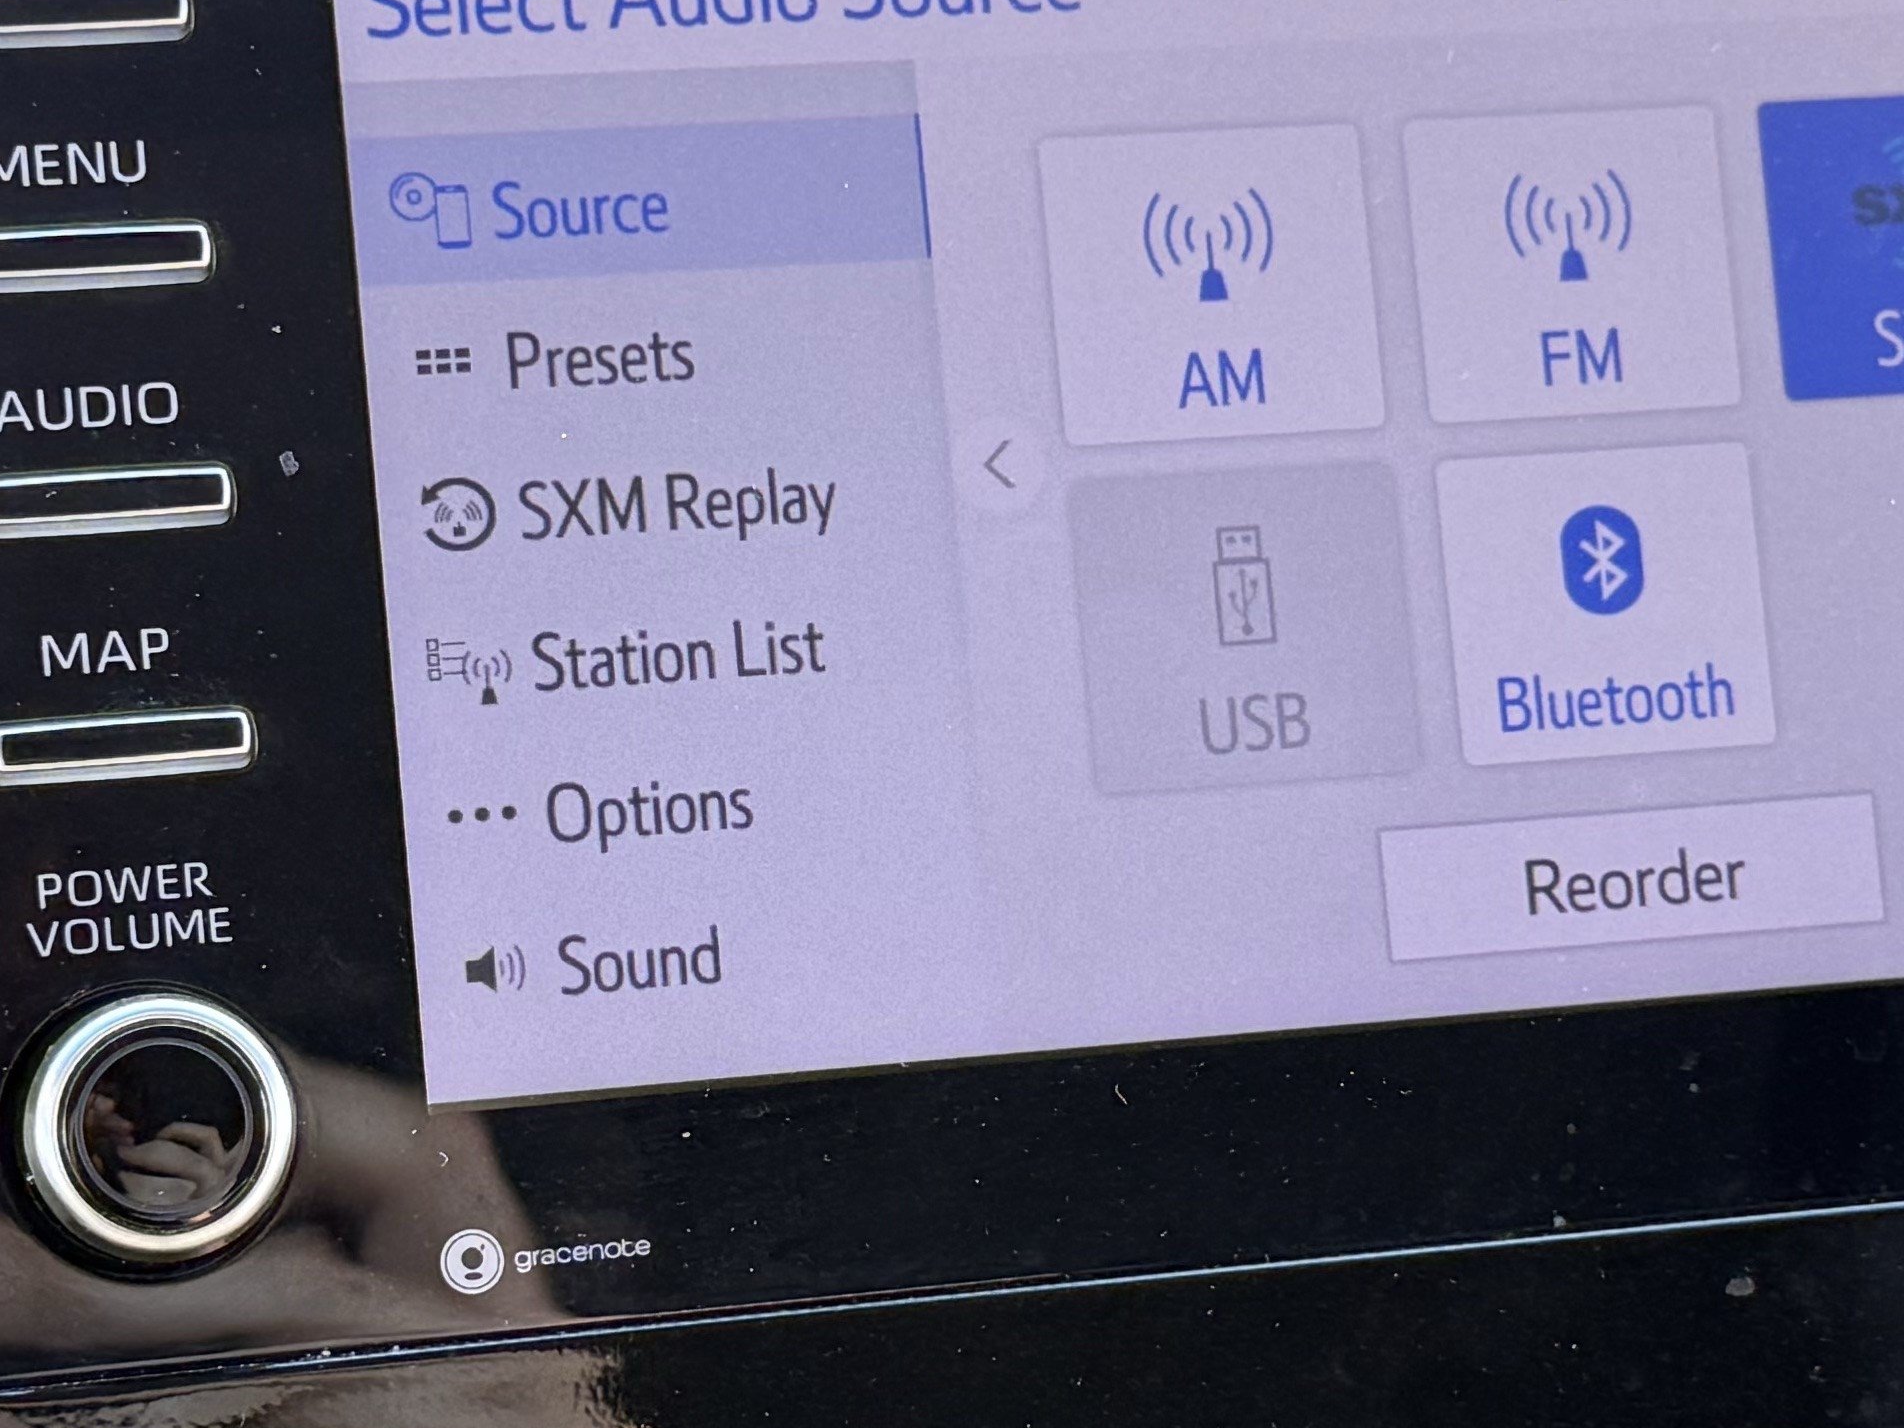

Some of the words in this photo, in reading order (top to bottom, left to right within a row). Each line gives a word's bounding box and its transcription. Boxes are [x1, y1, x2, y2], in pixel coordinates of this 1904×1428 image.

[493, 181, 668, 240] Source
[507, 332, 694, 389] Presets
[1180, 348, 1265, 408] AM
[1541, 328, 1622, 386] FM
[519, 476, 646, 540] SXM
[666, 467, 835, 541] Replay
[42, 628, 168, 676] MAP
[532, 630, 715, 691] Station
[733, 620, 825, 677] List
[1199, 692, 1310, 755] USB
[1498, 663, 1734, 732] Bluetooth
[547, 781, 753, 853] Options
[37, 861, 213, 909] POWER
[1525, 848, 1745, 915] Reorder
[26, 906, 234, 958] VOLUME
[558, 925, 721, 995] Sound
[513, 1238, 651, 1274] gracenote
